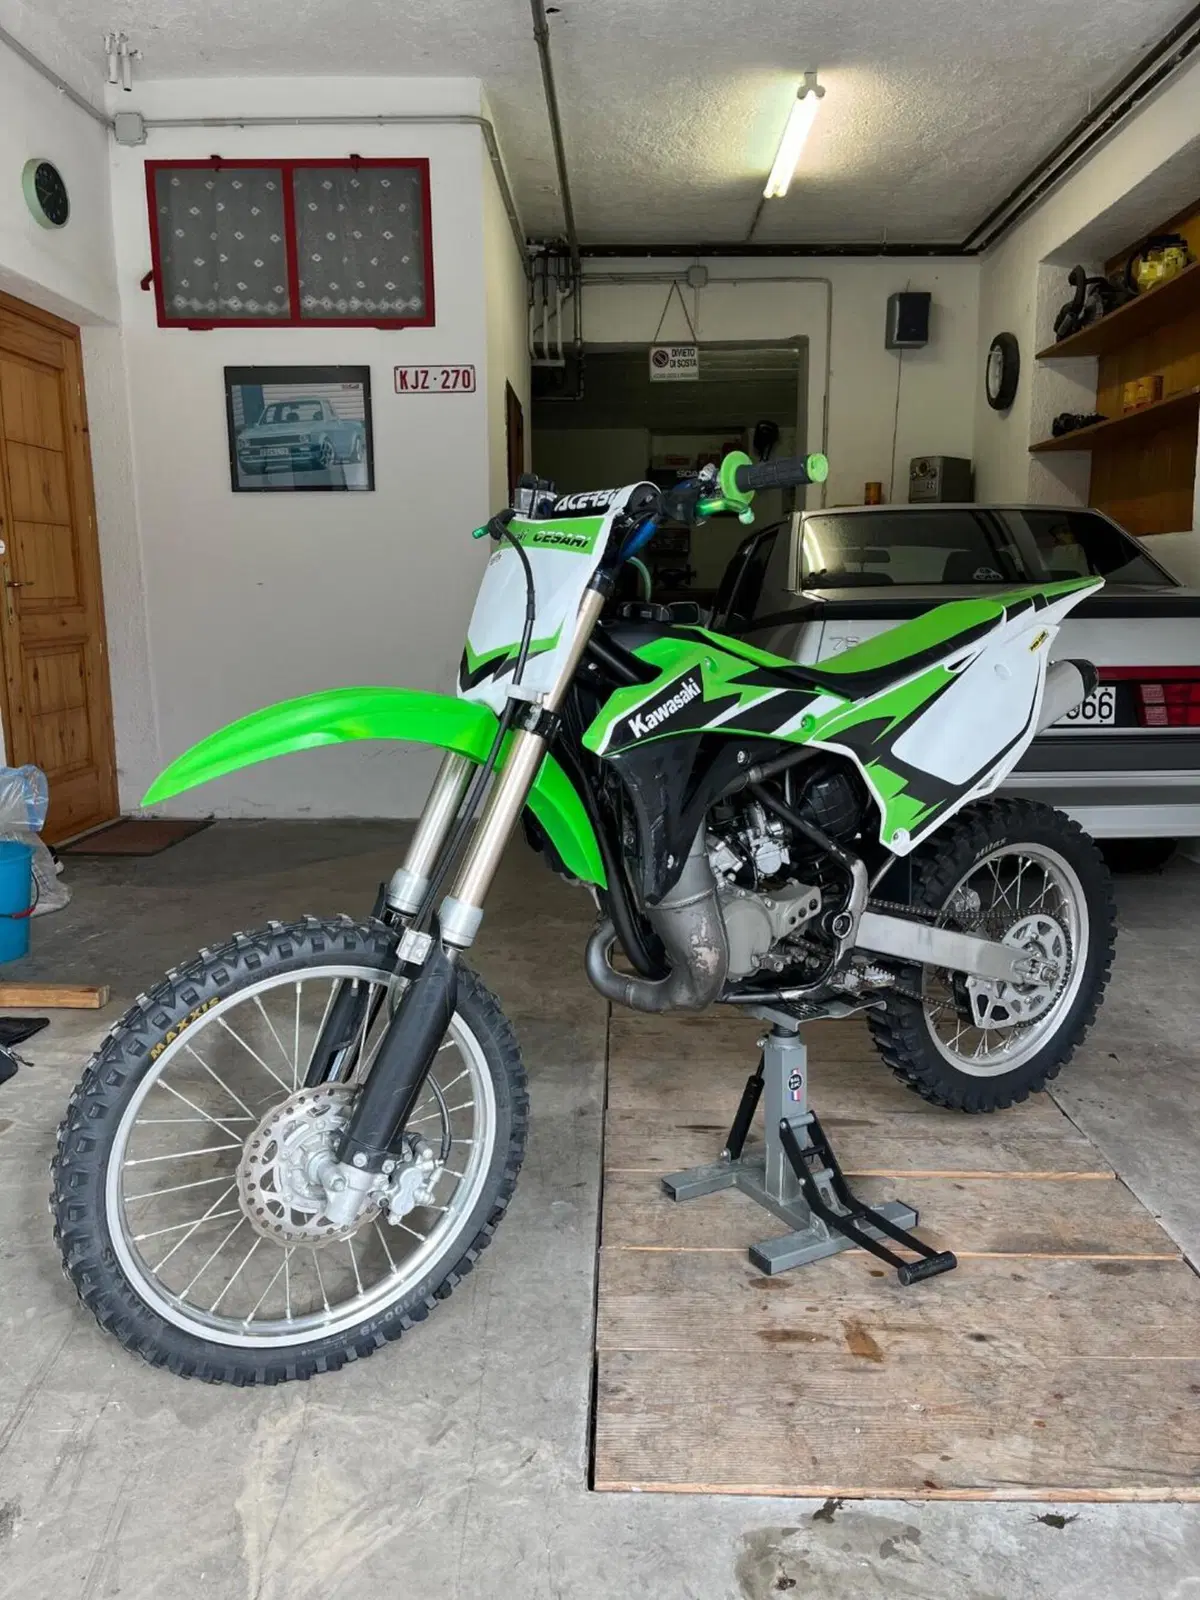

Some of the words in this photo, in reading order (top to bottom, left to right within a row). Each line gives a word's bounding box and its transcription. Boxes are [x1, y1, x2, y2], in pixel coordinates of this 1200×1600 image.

[669, 359, 676, 368] DI
[677, 358, 698, 368] SOSTA
[671, 348, 695, 358] DIVIETO
[628, 677, 702, 739] Kawasaki
[150, 996, 220, 1060] MAXXIS
